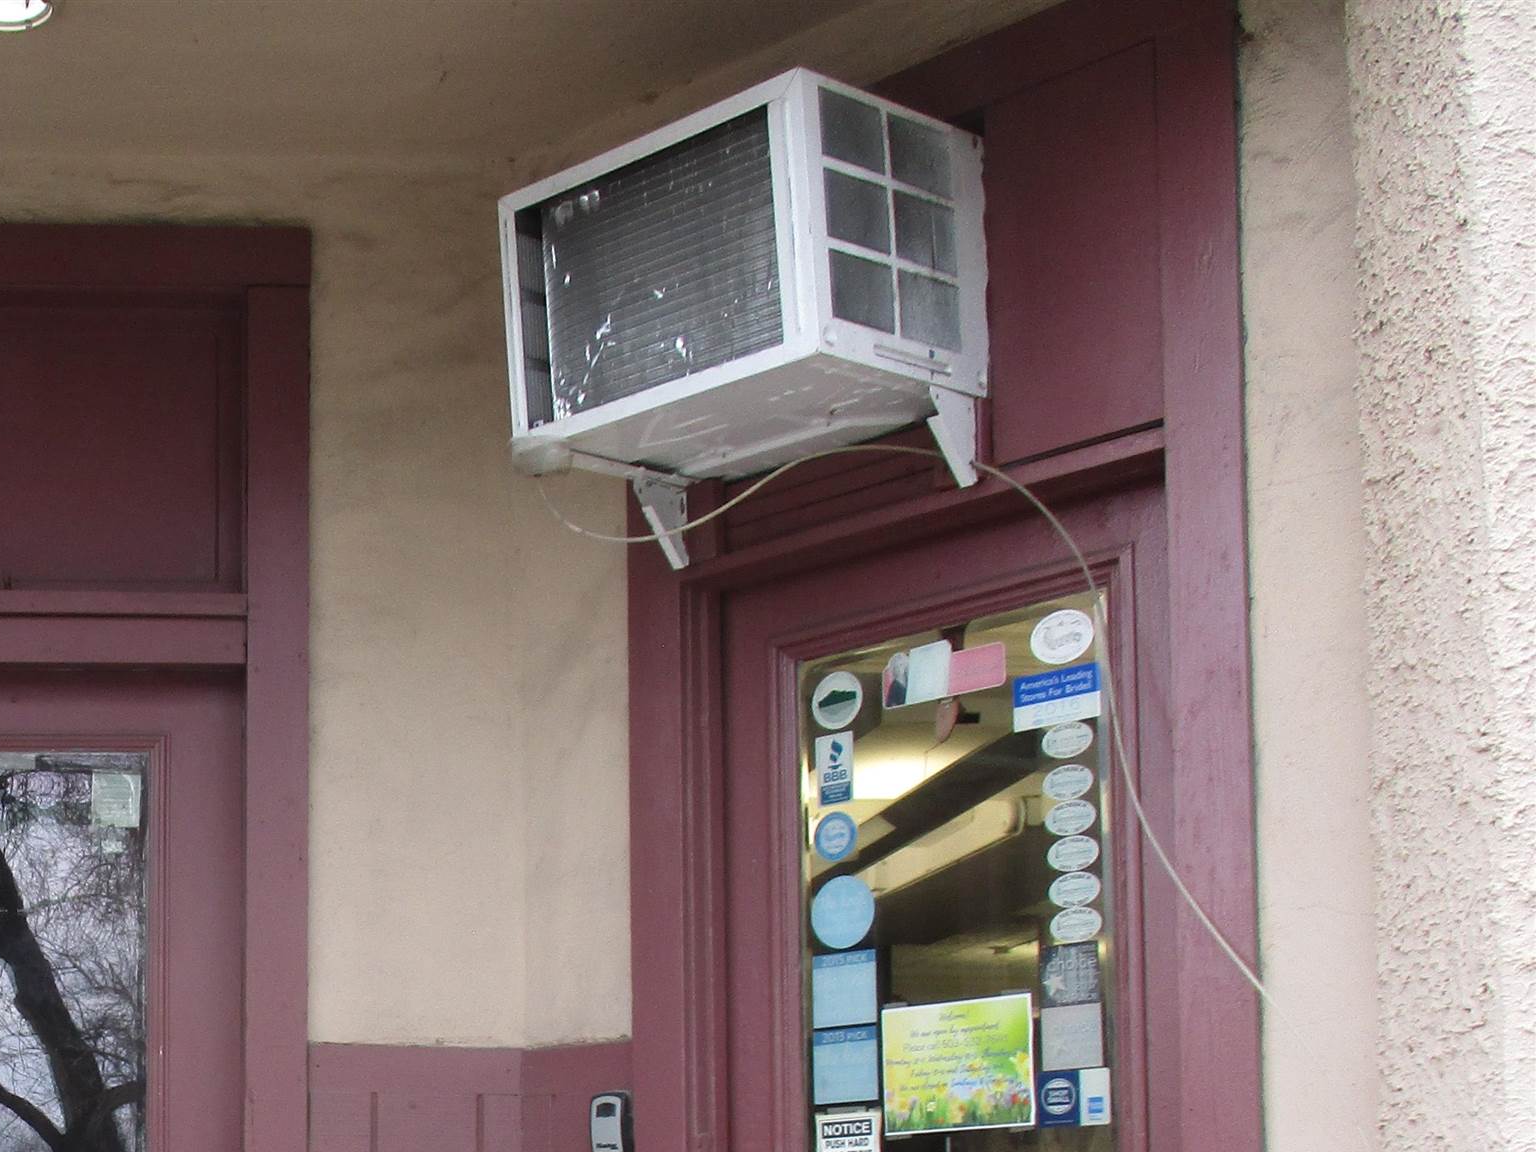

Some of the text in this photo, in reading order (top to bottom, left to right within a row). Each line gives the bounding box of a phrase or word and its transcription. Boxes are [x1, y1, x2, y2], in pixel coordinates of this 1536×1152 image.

[823, 768, 848, 783] BBB
[822, 1121, 872, 1137] NOTICE
[825, 1137, 869, 1149] PUSH HARD
